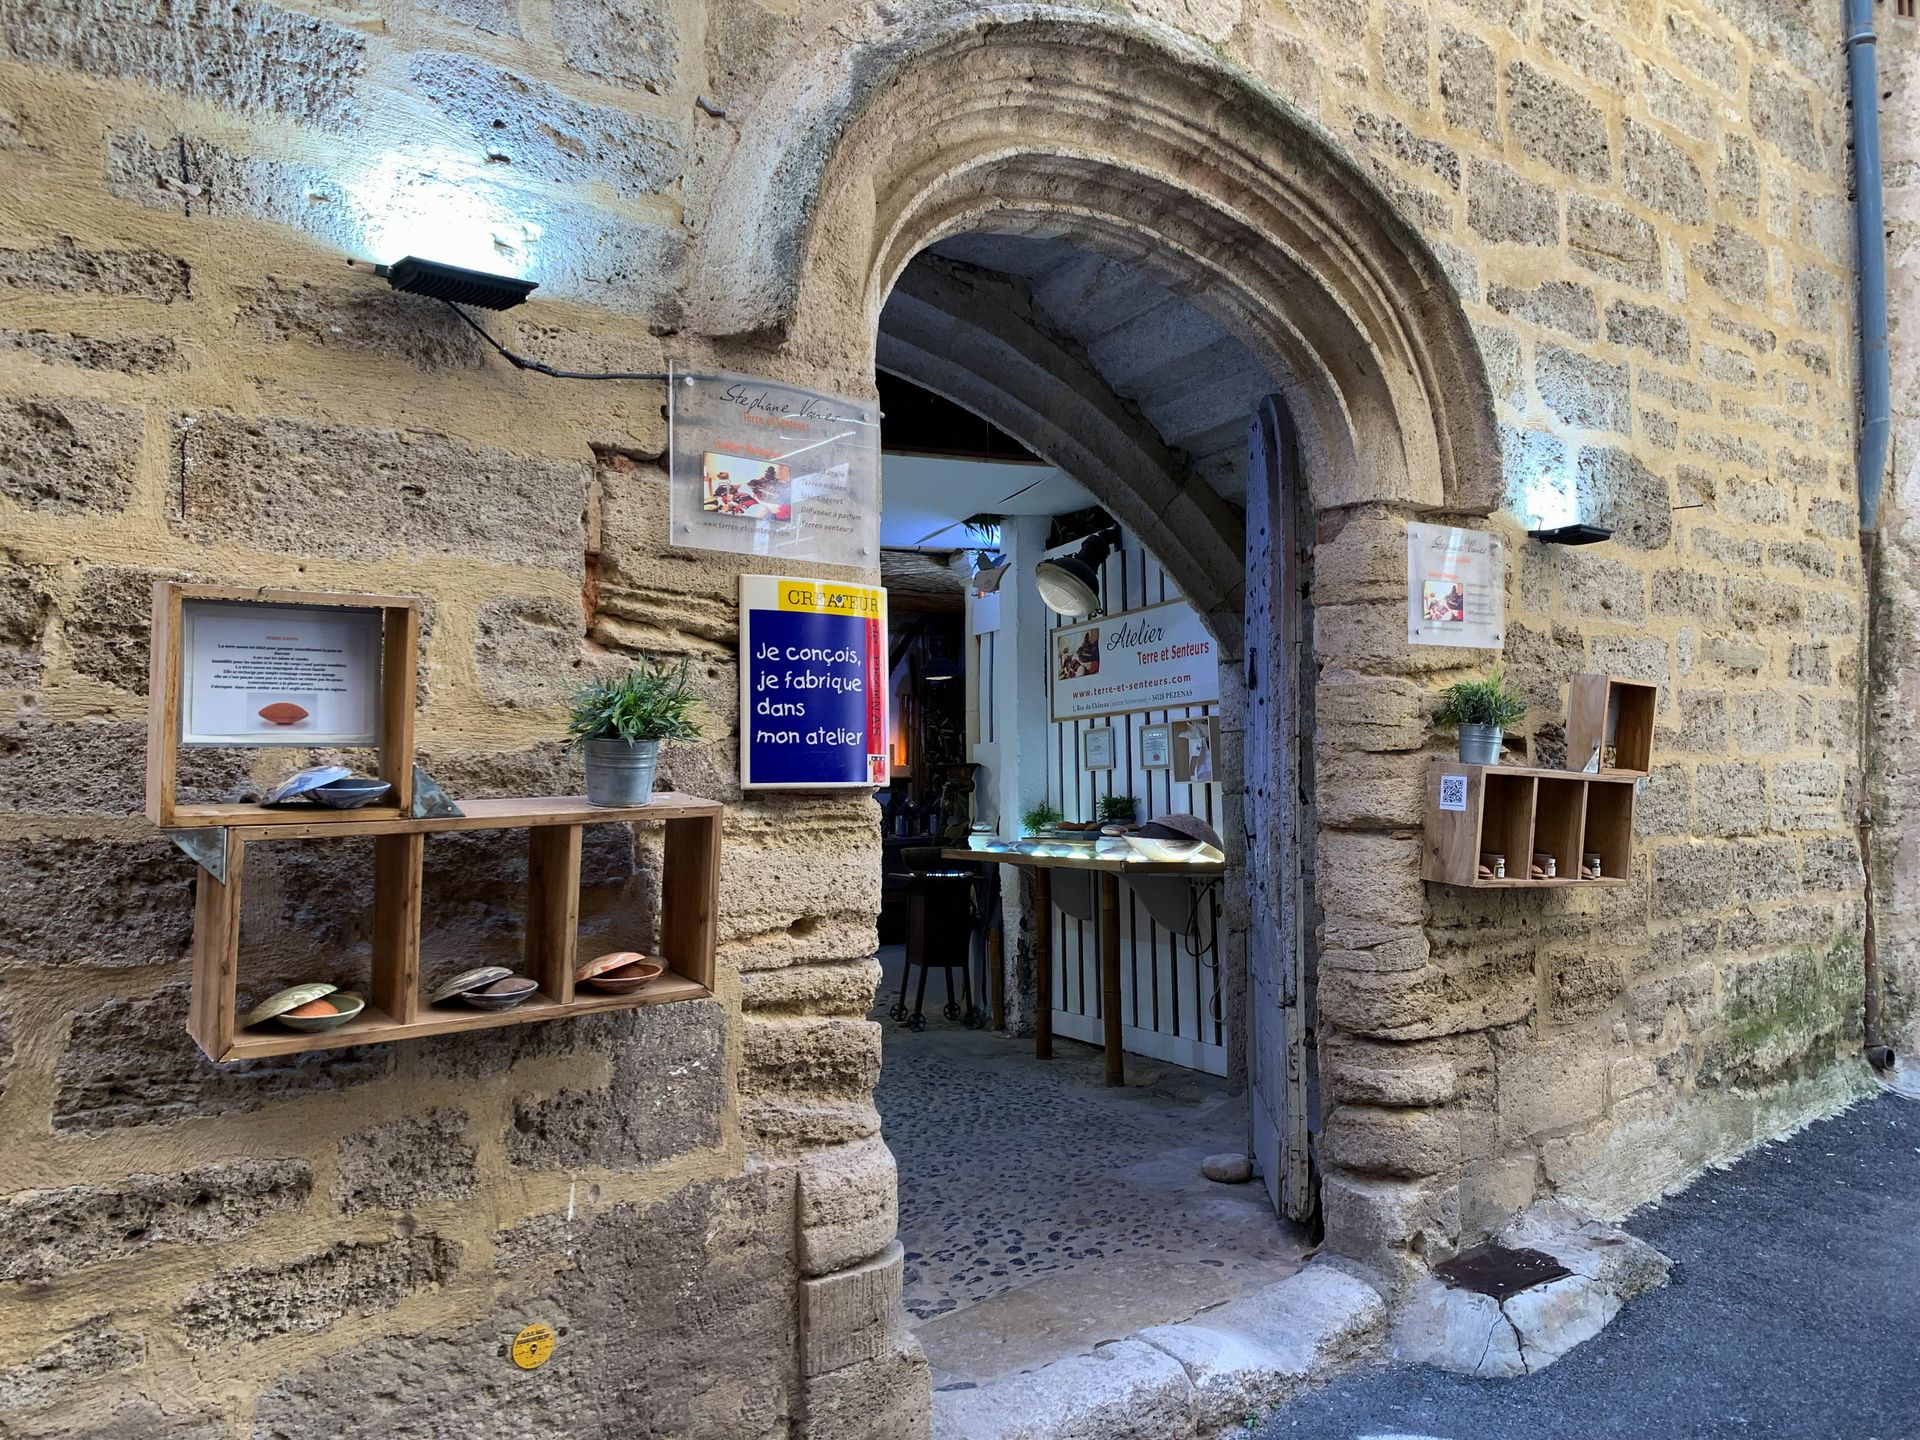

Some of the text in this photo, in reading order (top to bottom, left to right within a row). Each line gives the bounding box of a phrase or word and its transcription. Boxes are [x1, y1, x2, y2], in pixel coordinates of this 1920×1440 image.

[719, 384, 791, 413] Stephane
[801, 506, 831, 516] Diffuseur
[838, 511, 861, 520] parfum
[824, 524, 854, 533] senteurs
[1106, 618, 1166, 651] Atelier
[756, 642, 862, 666] Je conçois,
[1137, 641, 1210, 665] Terre et Senteurs
[757, 669, 862, 694] je fabrique
[1072, 673, 1191, 699] www.terre-et-senteurs.com
[757, 697, 805, 717] dans
[756, 727, 863, 745] mon atelier
